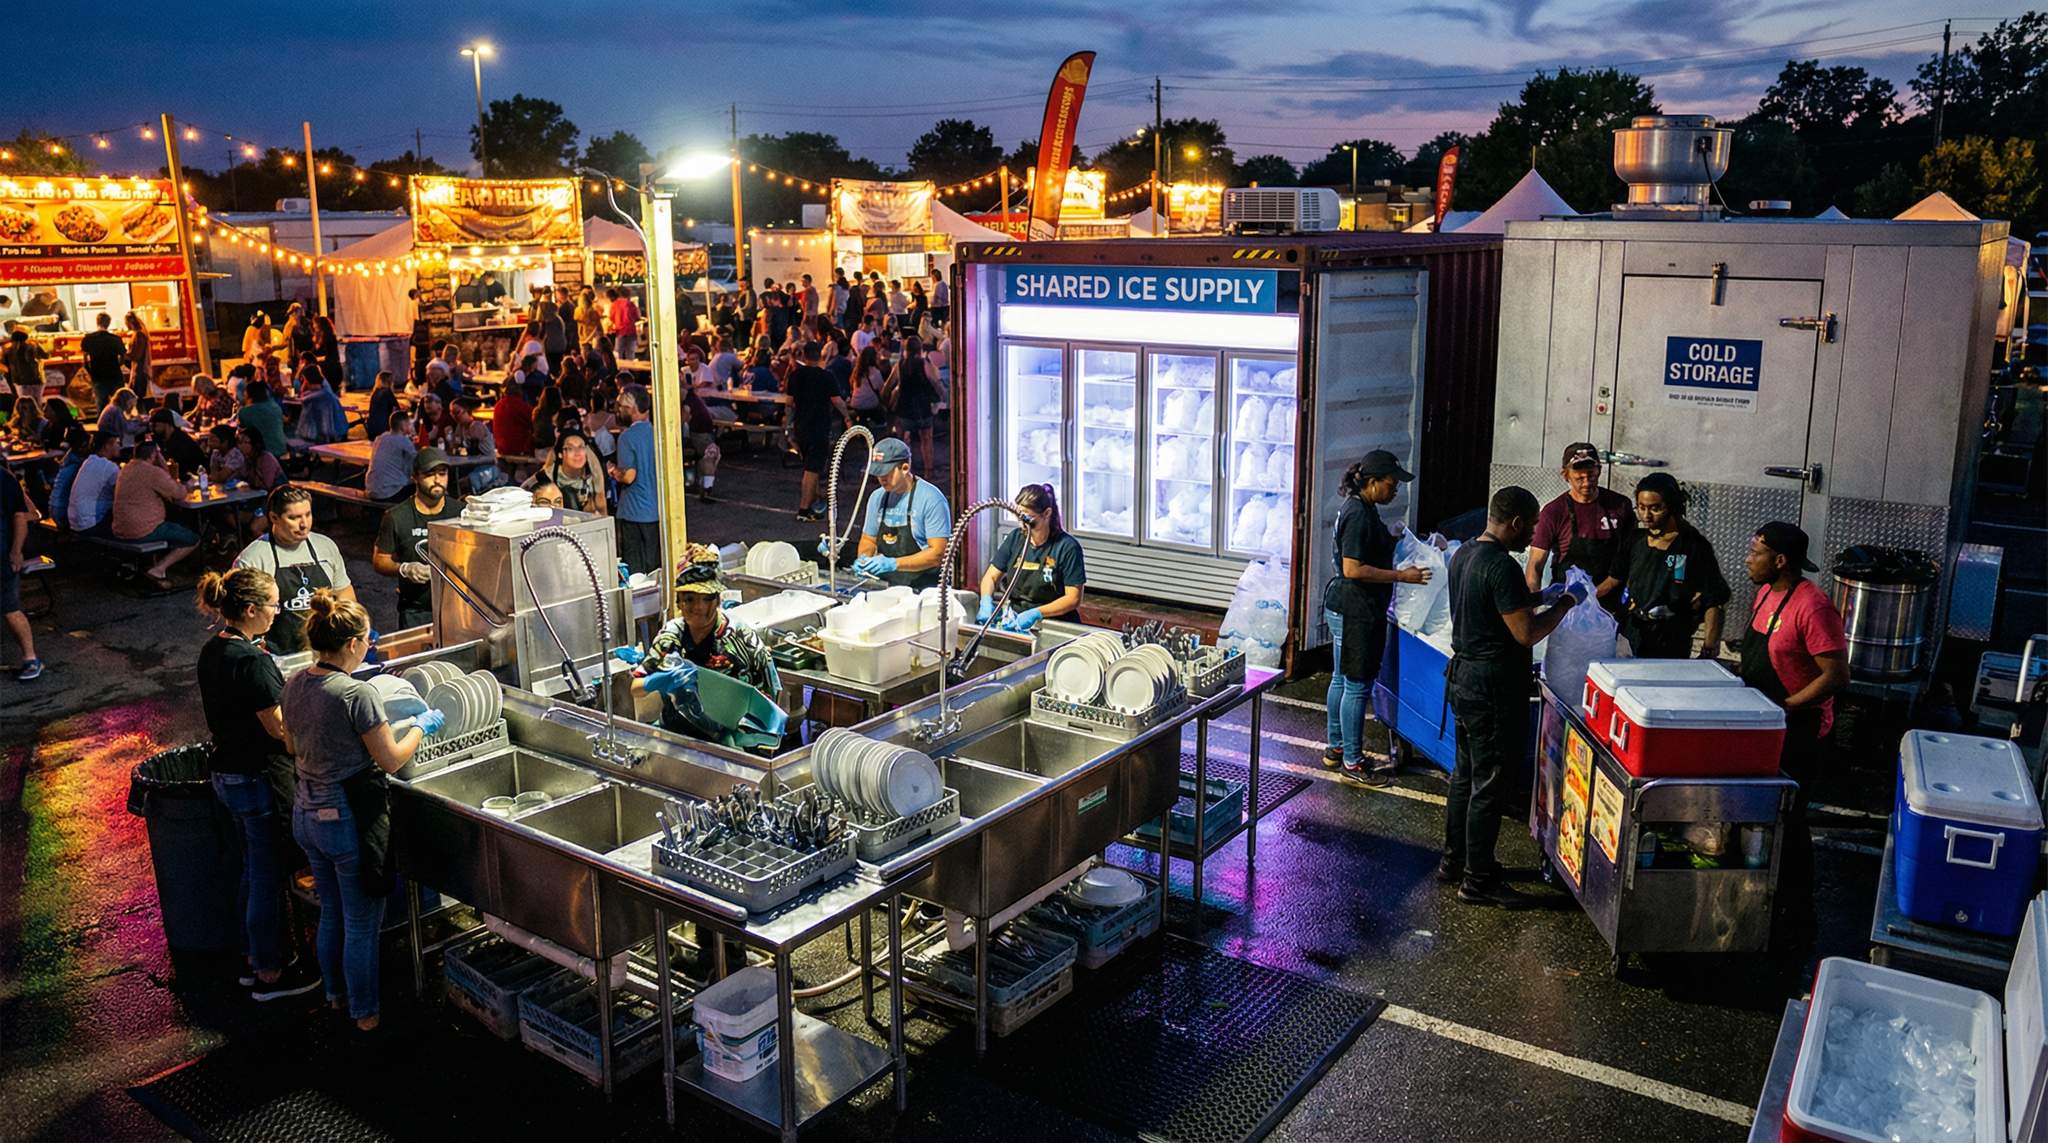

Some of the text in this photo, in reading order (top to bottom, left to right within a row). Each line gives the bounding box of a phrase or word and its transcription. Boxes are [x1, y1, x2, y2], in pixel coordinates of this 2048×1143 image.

[1016, 274, 1265, 304] SHARED ICE SUPPLY
[1689, 343, 1737, 362] COLD
[1669, 362, 1754, 385] STORAGE
